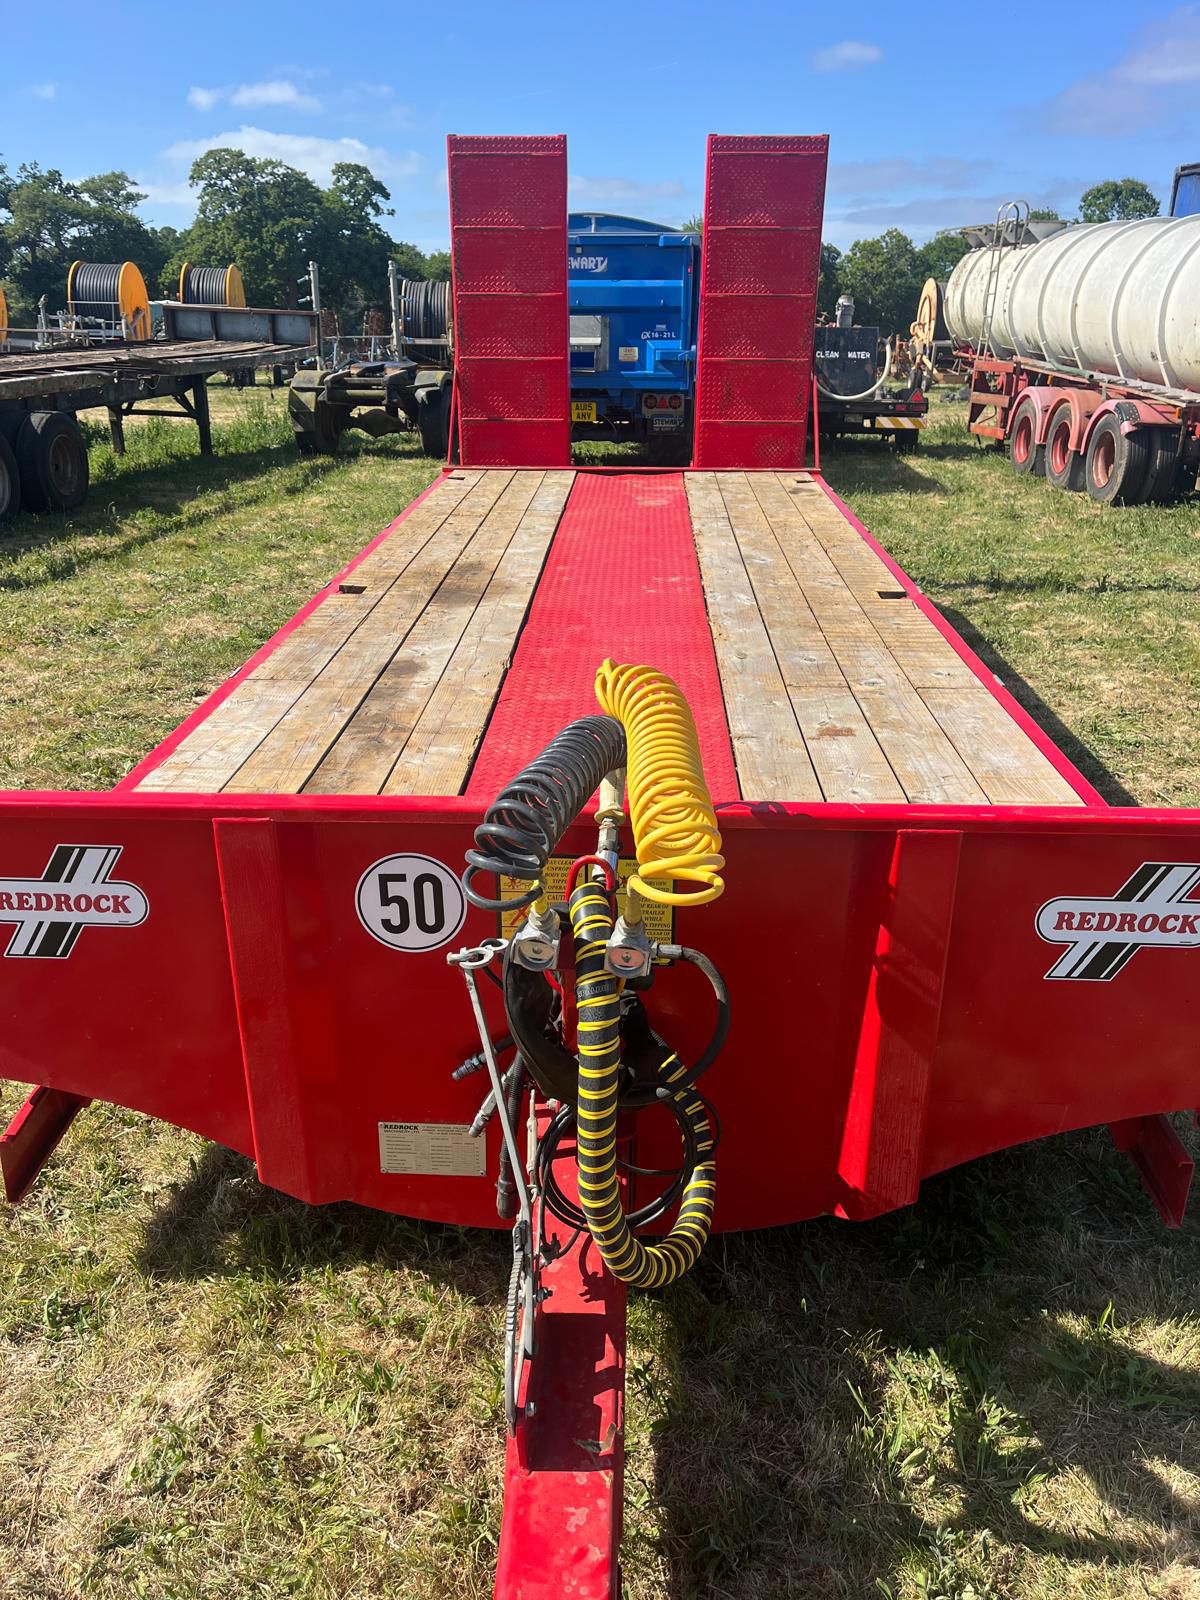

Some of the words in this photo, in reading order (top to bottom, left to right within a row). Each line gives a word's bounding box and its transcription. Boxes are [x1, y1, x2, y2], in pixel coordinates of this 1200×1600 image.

[815, 350, 840, 359] CLEAN
[847, 351, 871, 360] WATER
[576, 412, 592, 420] ANV
[0, 891, 132, 914] REDROCK
[378, 873, 445, 934] 50
[1053, 911, 1200, 935] REDROCK
